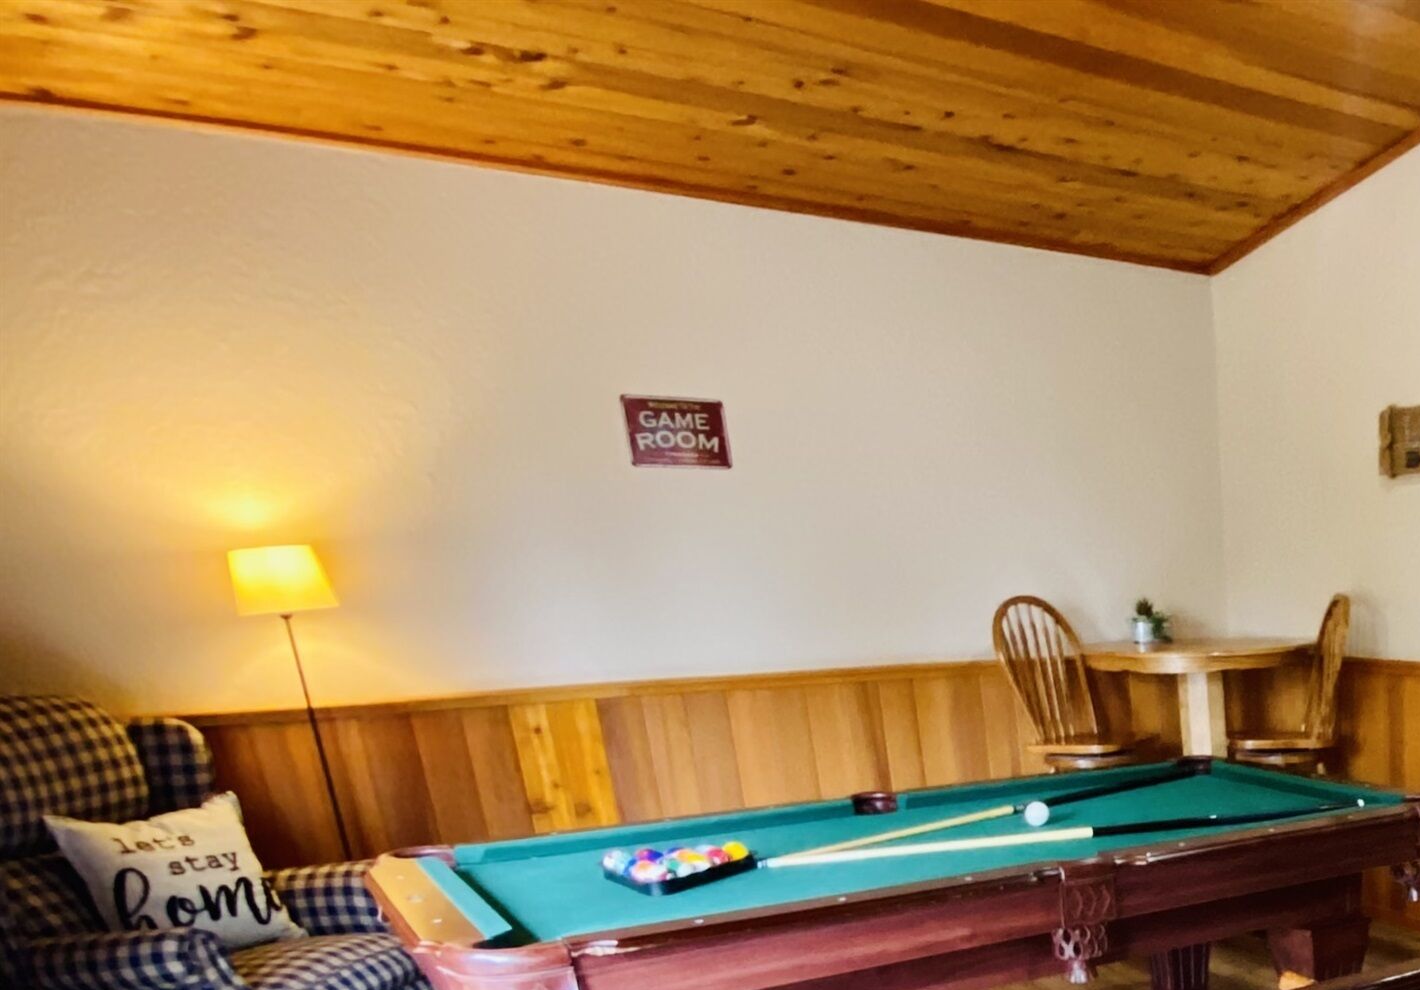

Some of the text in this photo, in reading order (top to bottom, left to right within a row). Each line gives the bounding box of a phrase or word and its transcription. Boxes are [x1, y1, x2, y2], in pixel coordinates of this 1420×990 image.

[639, 410, 710, 429] GAME
[635, 430, 719, 453] ROOM
[112, 832, 196, 855] let's
[168, 850, 241, 876] stay
